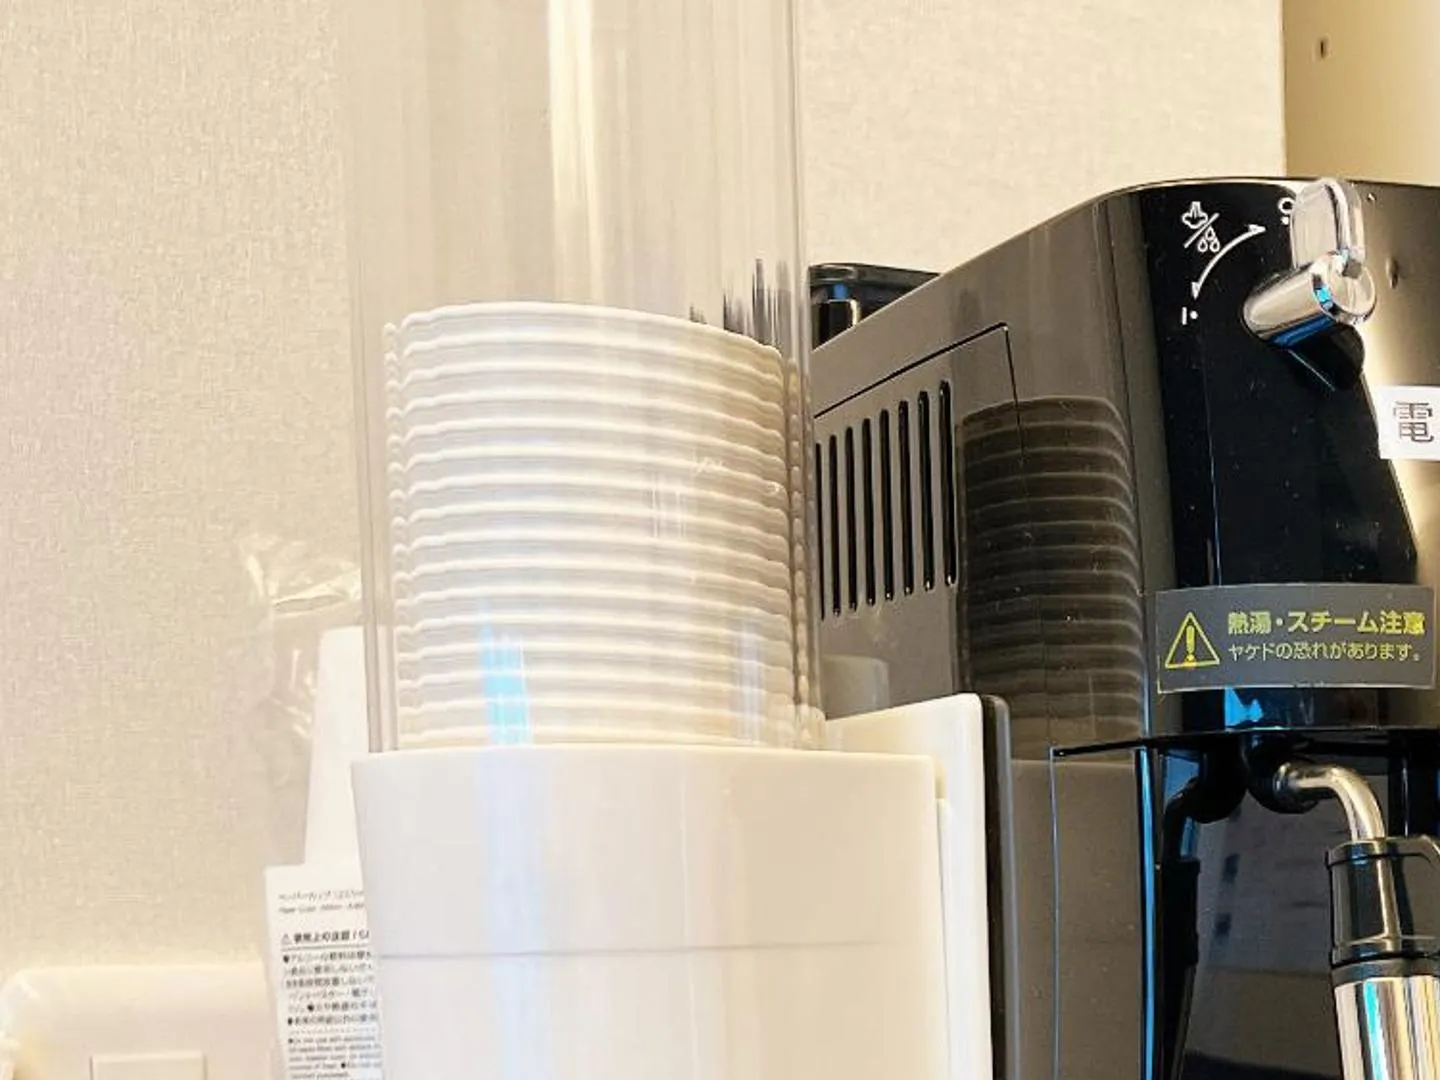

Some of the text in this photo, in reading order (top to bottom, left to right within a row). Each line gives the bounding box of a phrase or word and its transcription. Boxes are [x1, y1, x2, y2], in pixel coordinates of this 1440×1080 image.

[1227, 610, 1425, 635] 熱湯・スチーム注意
[1228, 641, 1422, 662] ヤケドの恐れがあります。
